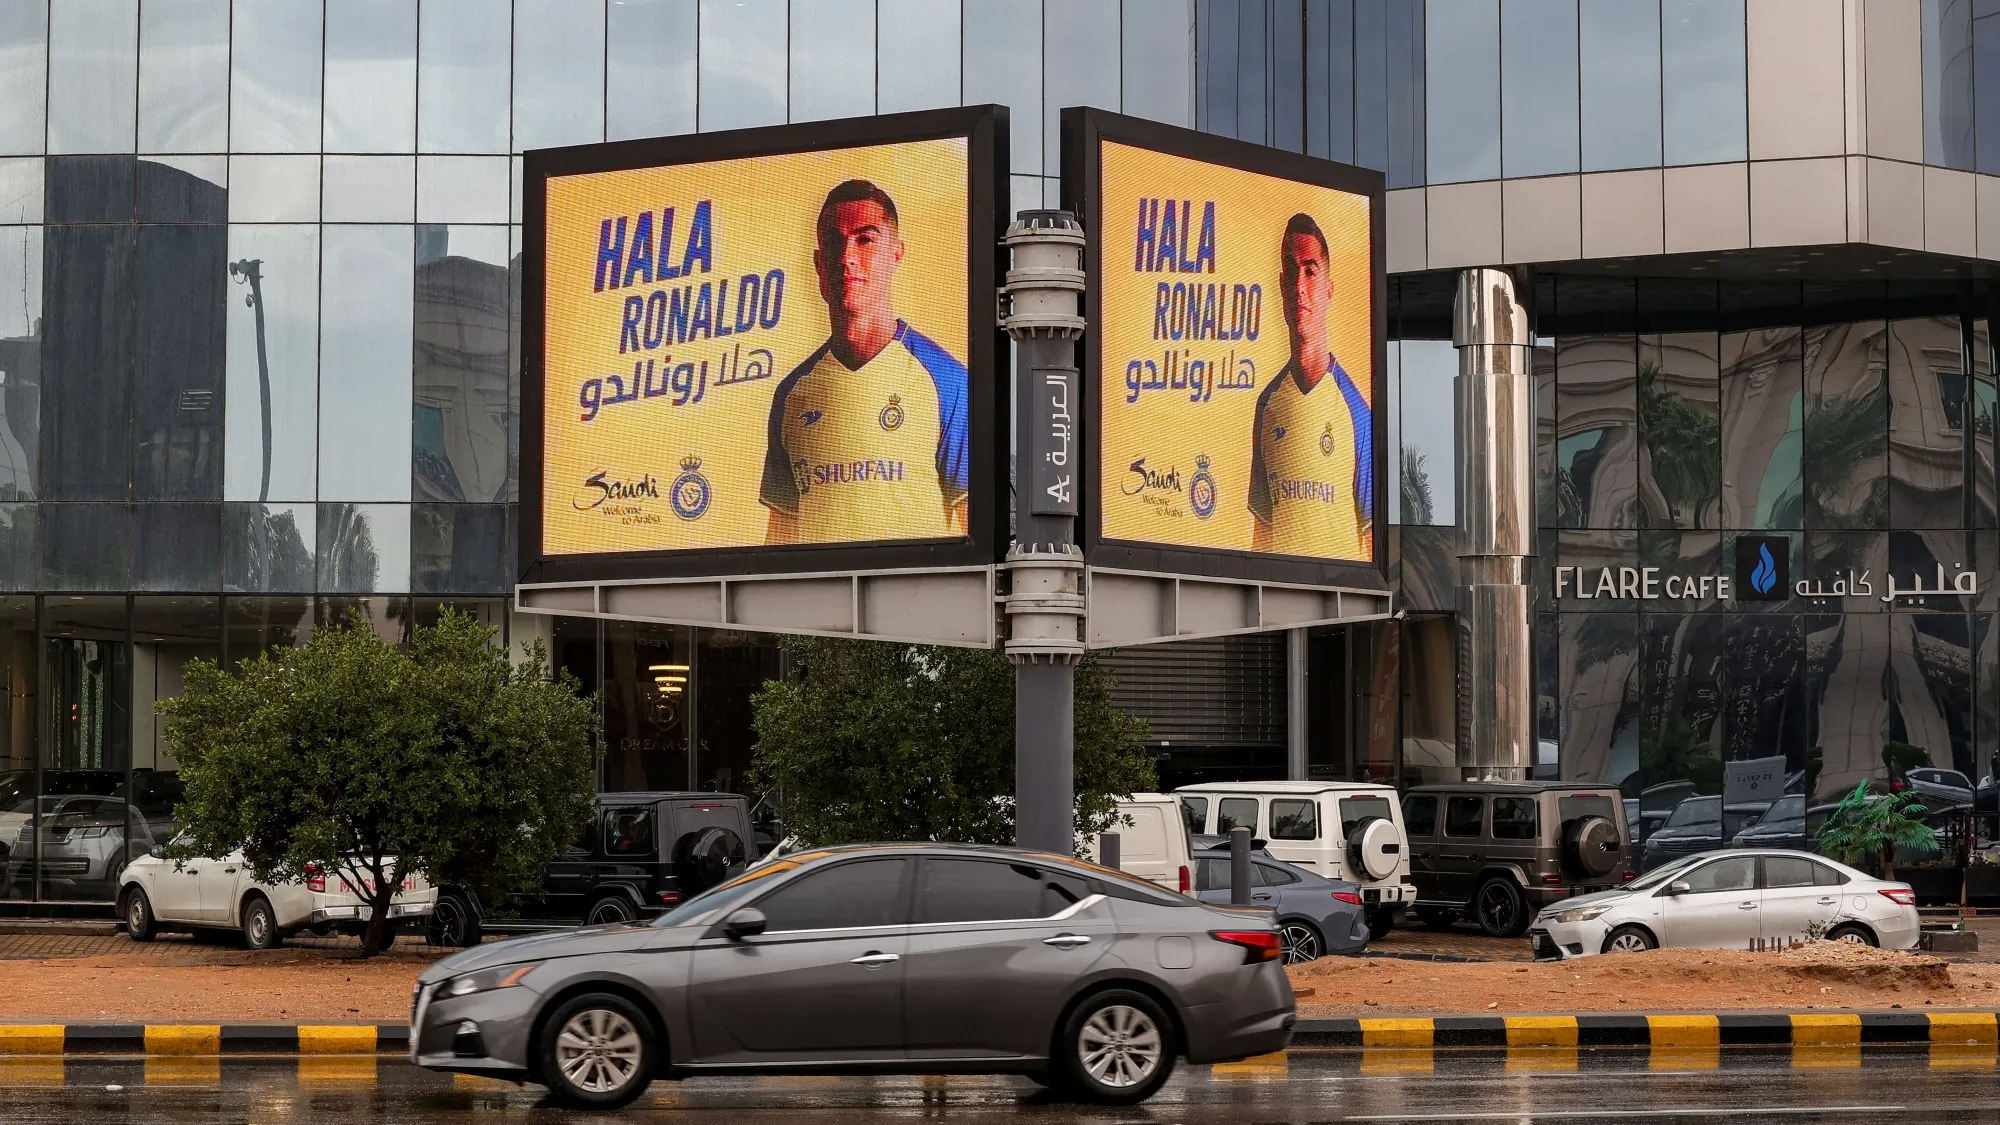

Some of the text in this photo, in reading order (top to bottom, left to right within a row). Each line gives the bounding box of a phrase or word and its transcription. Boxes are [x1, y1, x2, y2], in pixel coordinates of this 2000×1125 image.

[593, 199, 712, 294] HALA
[1134, 197, 1216, 274] HALA
[618, 268, 785, 355] RONALDO
[1153, 281, 1262, 341] RONALDO
[580, 343, 773, 422] هلا رونالدو
[1125, 349, 1256, 403] هلا رونالدو
[1046, 375, 1070, 466] العربية
[572, 469, 660, 511] Saudi
[813, 460, 904, 485] SHURFAH
[1120, 456, 1182, 496] Saudi
[1281, 479, 1334, 503] SHURFAH
[1555, 566, 1730, 600] FLARE CAFE
[1795, 561, 1977, 605] فلير كافيه
